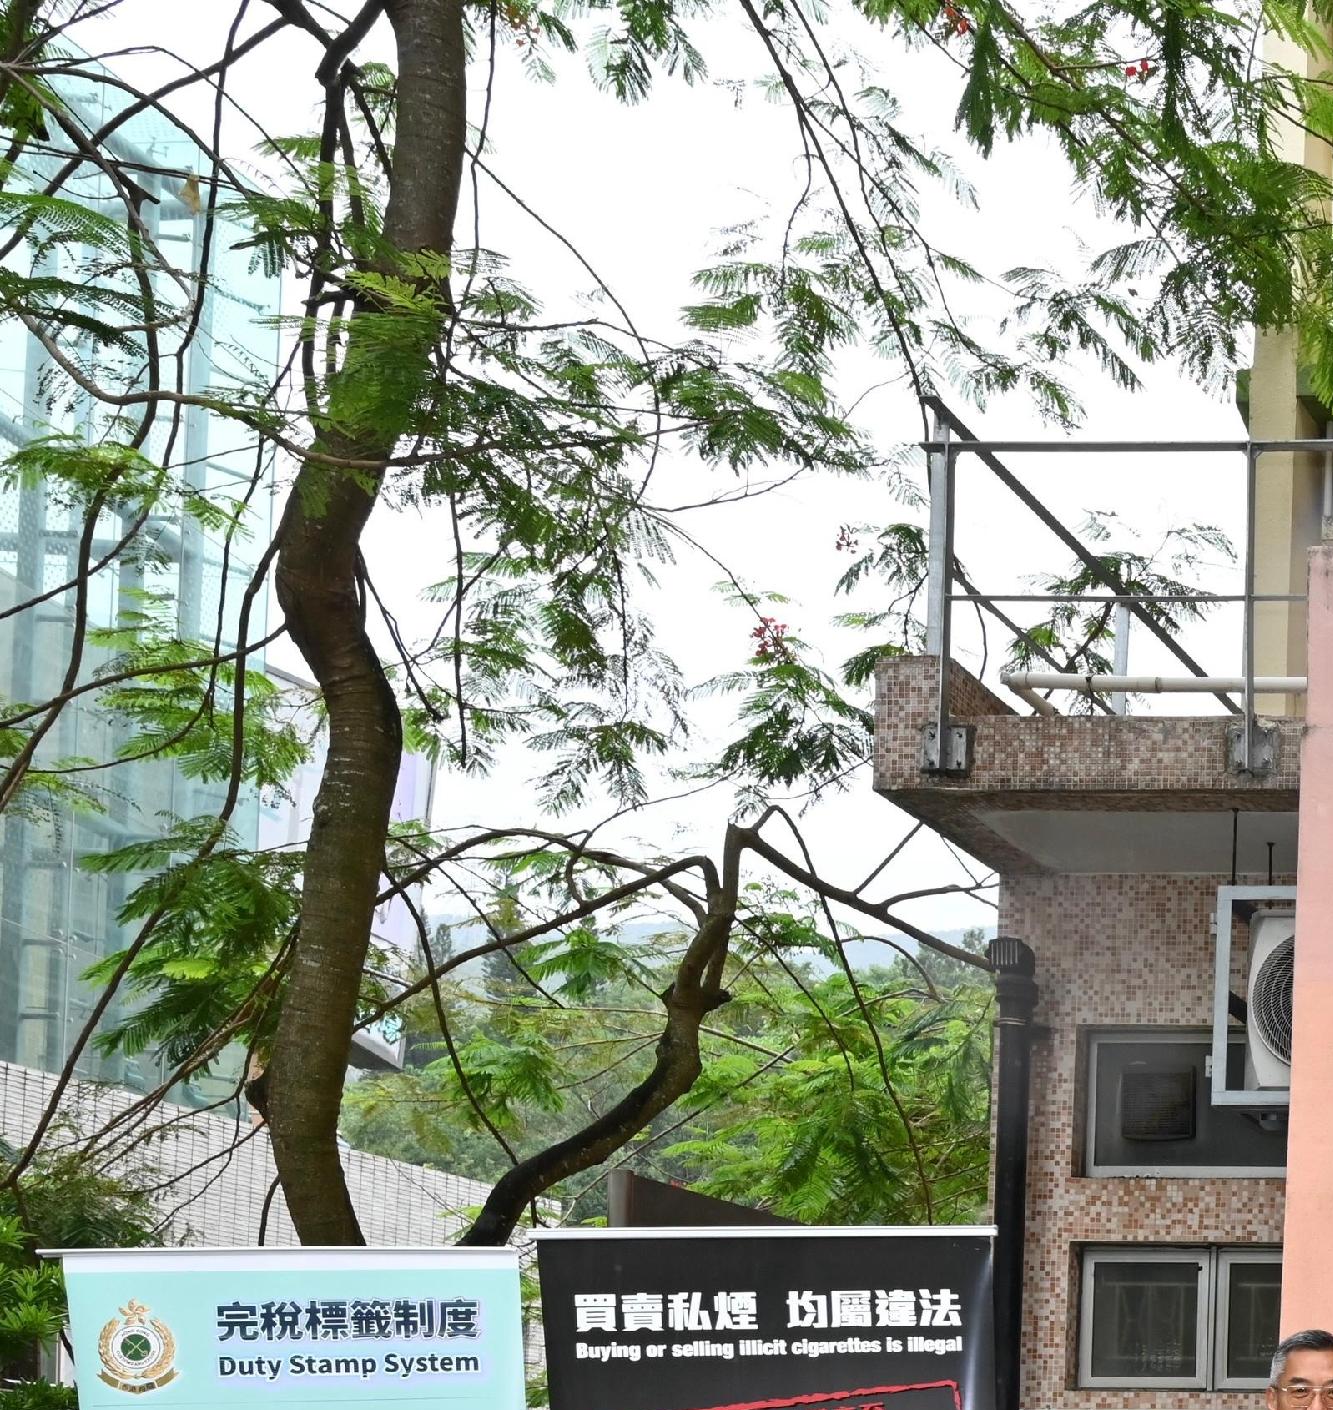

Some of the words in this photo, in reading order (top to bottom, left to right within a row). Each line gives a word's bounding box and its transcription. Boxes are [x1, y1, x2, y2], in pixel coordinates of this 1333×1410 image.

[216, 1300, 480, 1341] 完稅標籤制度
[574, 1292, 758, 1333] 買賣私煙
[787, 1288, 962, 1329] 均屬違法
[576, 1343, 640, 1362] Buying
[647, 1343, 666, 1357] or
[672, 1341, 734, 1360] selling
[739, 1339, 787, 1356] illicit
[791, 1337, 881, 1357] cigarettes
[886, 1337, 902, 1354] is
[907, 1335, 962, 1355] illegal
[219, 1355, 281, 1379] Duty
[290, 1355, 376, 1379] Stamp
[385, 1353, 479, 1377] System
